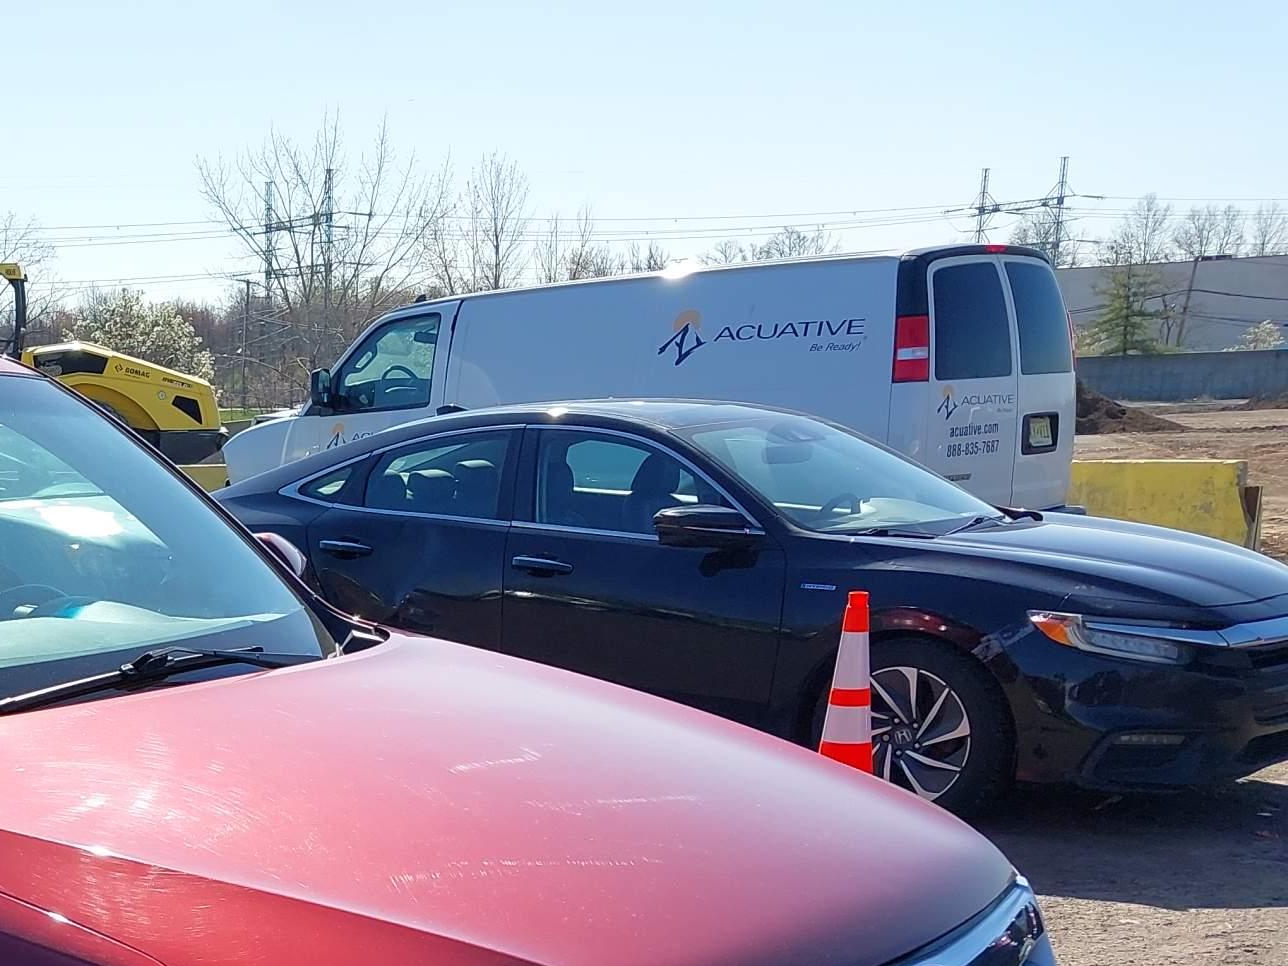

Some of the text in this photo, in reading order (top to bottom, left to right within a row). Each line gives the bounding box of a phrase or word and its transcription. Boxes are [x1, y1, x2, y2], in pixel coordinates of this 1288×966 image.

[713, 318, 866, 342] ACUATIVE
[809, 341, 862, 352] Be Ready!
[961, 393, 1015, 406] ACUATIVE
[949, 422, 999, 438] acuative.com
[946, 440, 1000, 458] 888-835-7687
